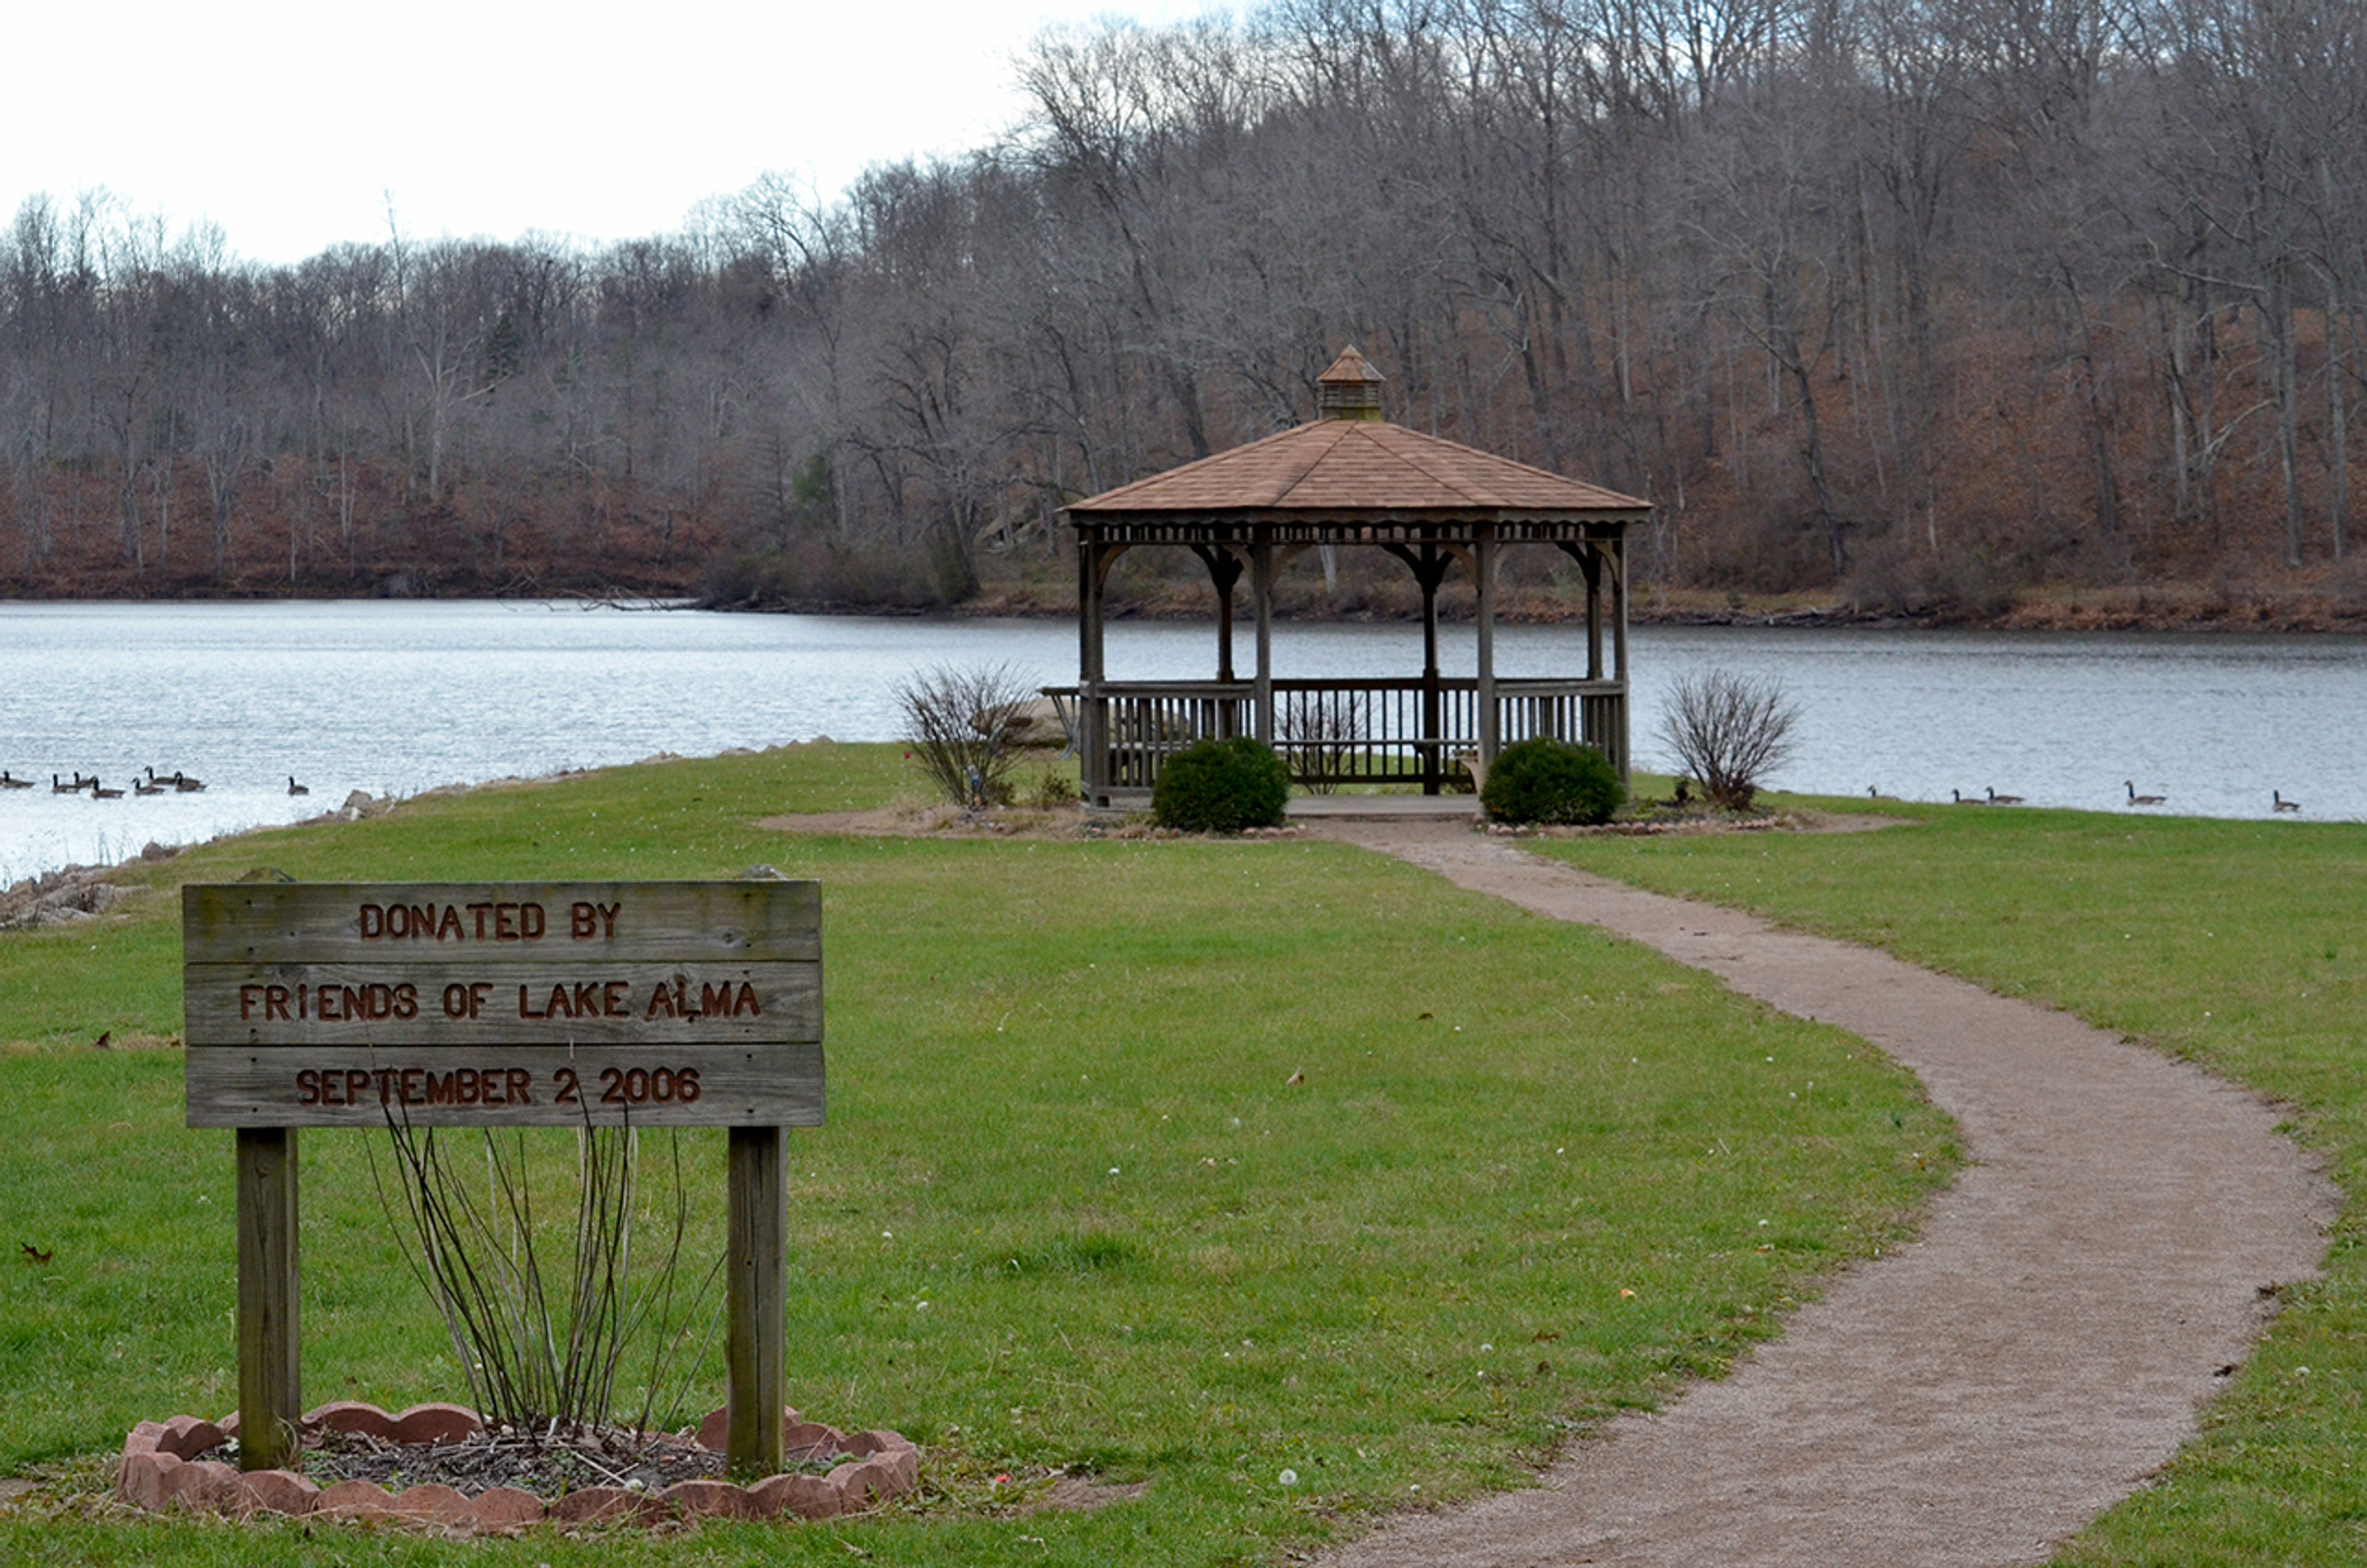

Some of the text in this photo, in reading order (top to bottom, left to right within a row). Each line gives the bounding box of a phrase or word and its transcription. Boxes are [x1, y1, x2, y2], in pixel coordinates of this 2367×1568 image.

[360, 902, 621, 942] DONATED BY
[240, 981, 761, 1021] FRIENDS OF LAKE ALMA
[296, 1068, 532, 1107] SEPTEMBER
[599, 1067, 701, 1104] 2006
